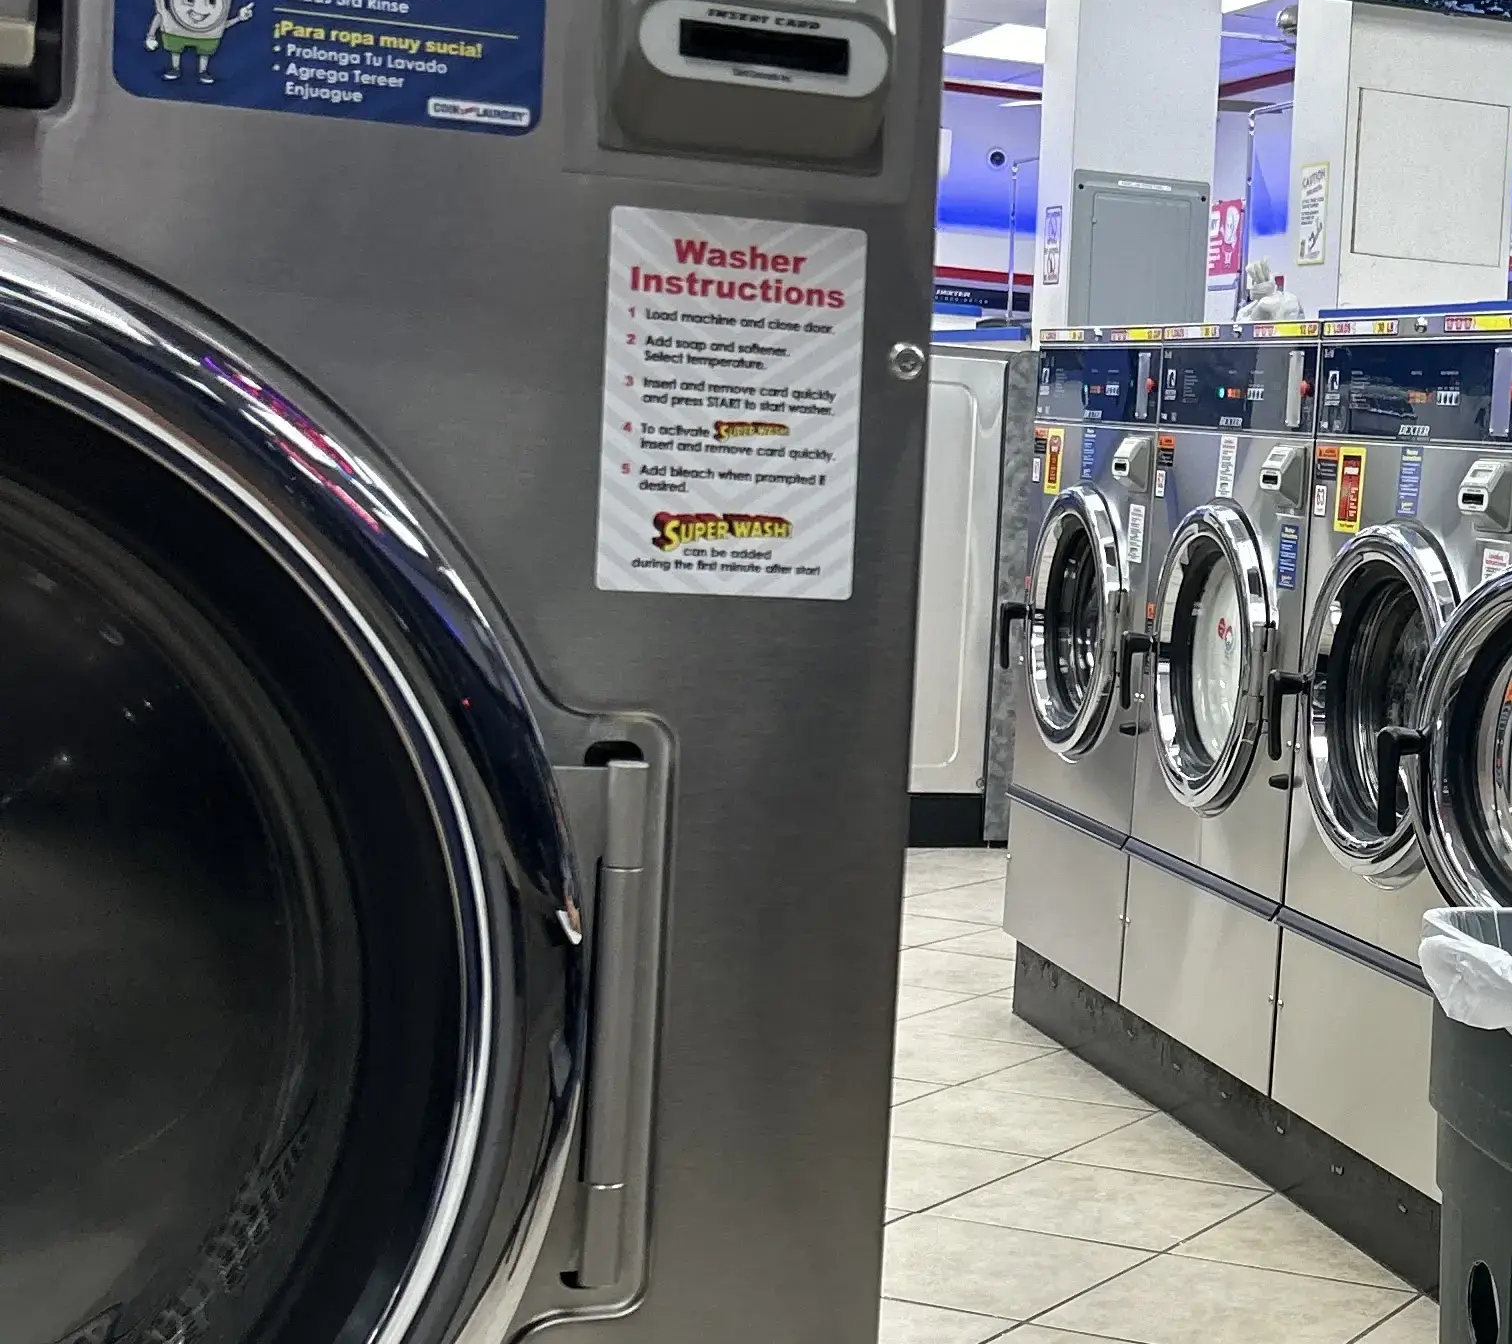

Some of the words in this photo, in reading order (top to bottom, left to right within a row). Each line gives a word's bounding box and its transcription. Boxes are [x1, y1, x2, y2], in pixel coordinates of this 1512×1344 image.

[707, 7, 771, 24] INSERT
[773, 16, 821, 30] CARD
[330, 28, 375, 48] ropa
[379, 33, 421, 54] muy
[424, 39, 483, 59] sucia!
[286, 43, 361, 66] Prolonga
[363, 52, 383, 68] Tu
[386, 55, 449, 75] Lavado
[285, 62, 349, 84] Agrega
[284, 80, 364, 104] Enjuague
[673, 237, 809, 275] Washer
[629, 265, 846, 309] Instructions
[627, 306, 637, 319] 1
[644, 307, 678, 322] Load
[680, 311, 737, 327] machine
[739, 317, 765, 329] and
[767, 320, 802, 333] close
[803, 322, 836, 335] door.
[626, 333, 637, 346] 2
[645, 335, 673, 348] Add
[675, 339, 708, 353] soap
[710, 341, 735, 354] and
[738, 343, 790, 358] softener.
[643, 350, 683, 365] Select
[686, 353, 768, 371] temperature.
[623, 375, 635, 387] 3
[643, 377, 677, 390] Insert
[679, 379, 705, 392] and
[707, 383, 757, 397] remove
[759, 385, 789, 399] card
[791, 387, 838, 405] quickly
[642, 392, 668, 406] and
[671, 396, 704, 409] press
[706, 396, 742, 410] START
[744, 399, 757, 411] to
[759, 400, 786, 413] start
[622, 422, 634, 433] 4
[640, 422, 656, 435] To
[657, 424, 711, 438] activate
[1398, 424, 1431, 437] DEXTER
[639, 437, 674, 451] Insert
[676, 441, 703, 454] and
[704, 444, 754, 457] remove
[755, 445, 785, 458] card
[620, 463, 631, 475] 5
[639, 464, 667, 477] Add
[669, 466, 715, 481] bleach
[717, 469, 752, 482] when
[755, 472, 816, 487] prompted
[638, 479, 690, 494] desired.
[660, 518, 730, 553] SUPER
[682, 547, 708, 558] can
[710, 546, 727, 559] be
[730, 548, 772, 561] added
[631, 557, 671, 572] during
[673, 558, 694, 570] the
[696, 559, 717, 572] first
[719, 561, 762, 574] minute
[764, 562, 793, 576] after
